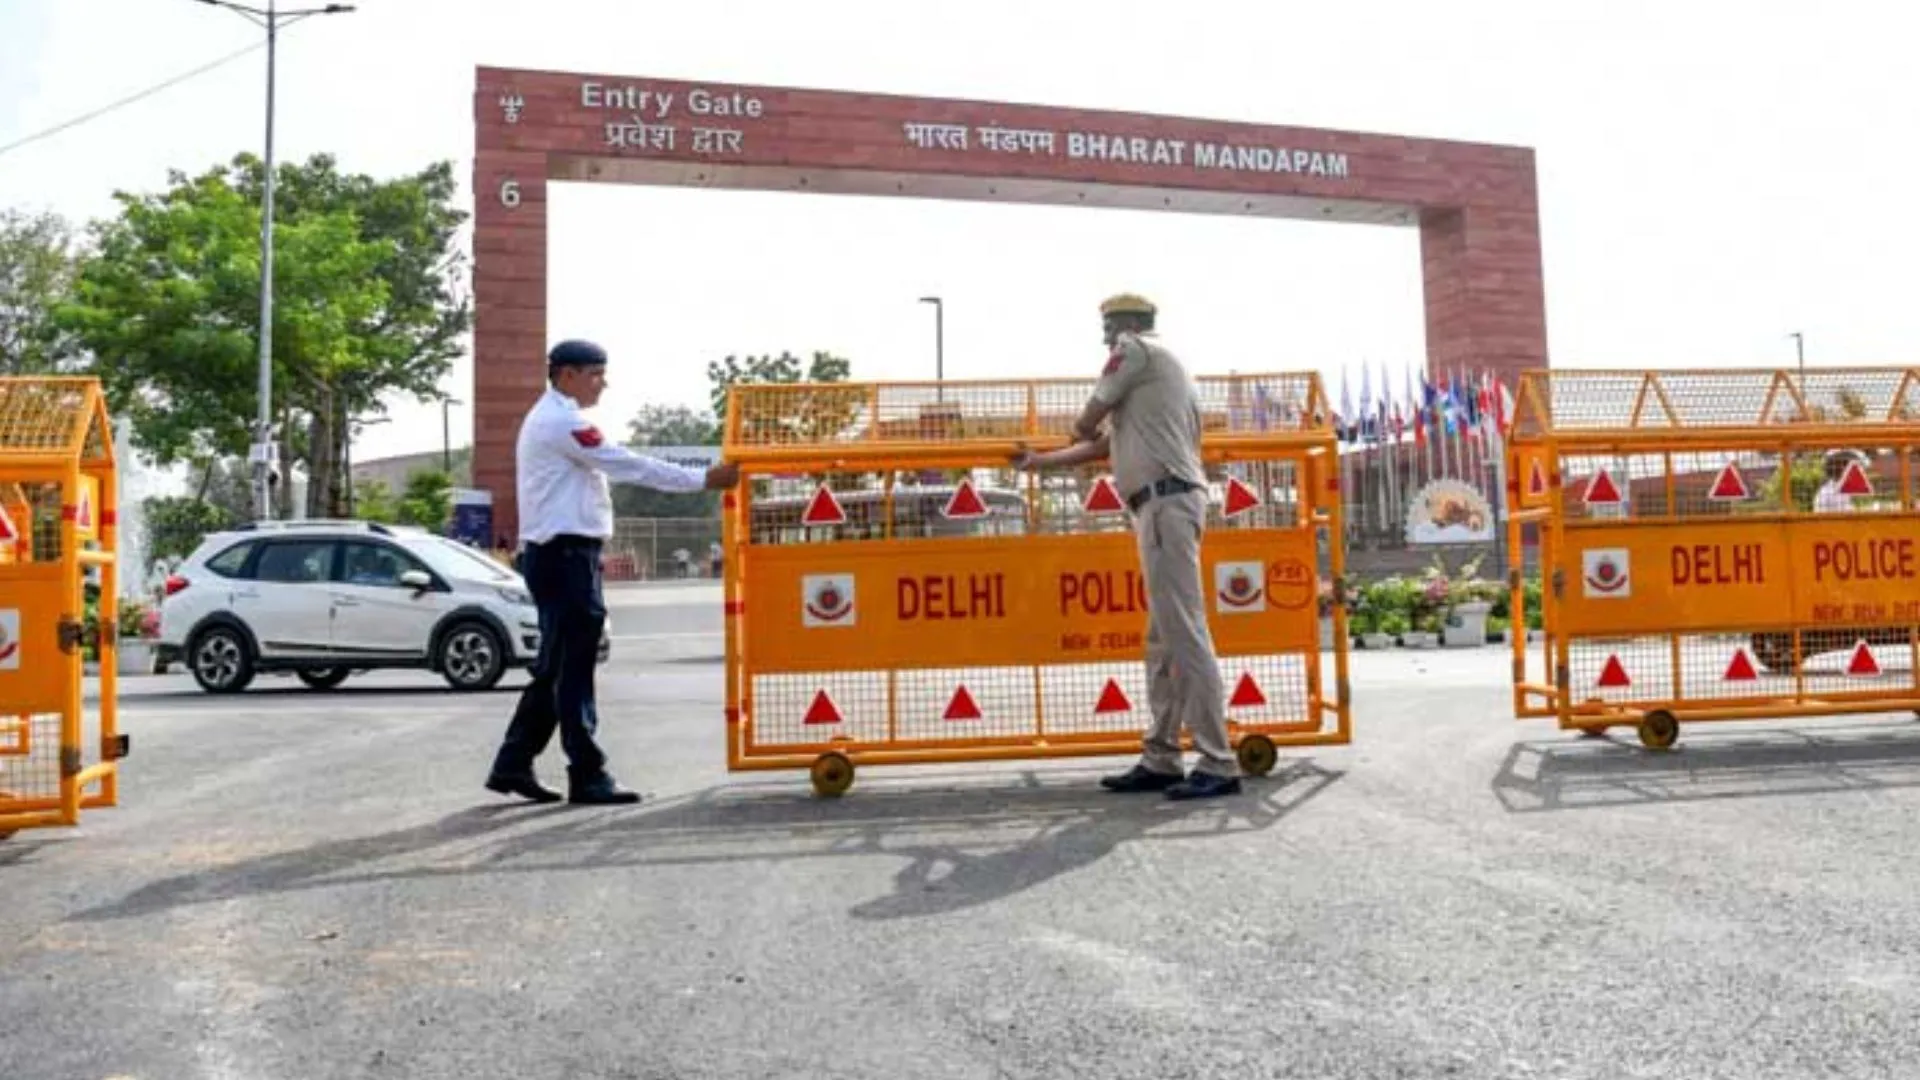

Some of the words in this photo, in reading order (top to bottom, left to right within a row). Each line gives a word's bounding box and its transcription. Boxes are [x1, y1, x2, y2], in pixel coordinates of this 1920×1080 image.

[581, 82, 673, 117] Entry
[688, 89, 763, 117] Gate
[605, 115, 675, 150] प्रवेश
[691, 126, 744, 154] द्वार
[903, 122, 968, 150] भारत
[976, 119, 1055, 155] मंडपम
[1067, 132, 1186, 165] BHARAT
[1194, 143, 1349, 178] MANDAPAM
[501, 180, 521, 207] 6
[1671, 543, 1765, 585] DELHI
[1813, 538, 1917, 584] POLICE
[897, 571, 1006, 620] DELHI
[1060, 569, 1149, 617] POLI
